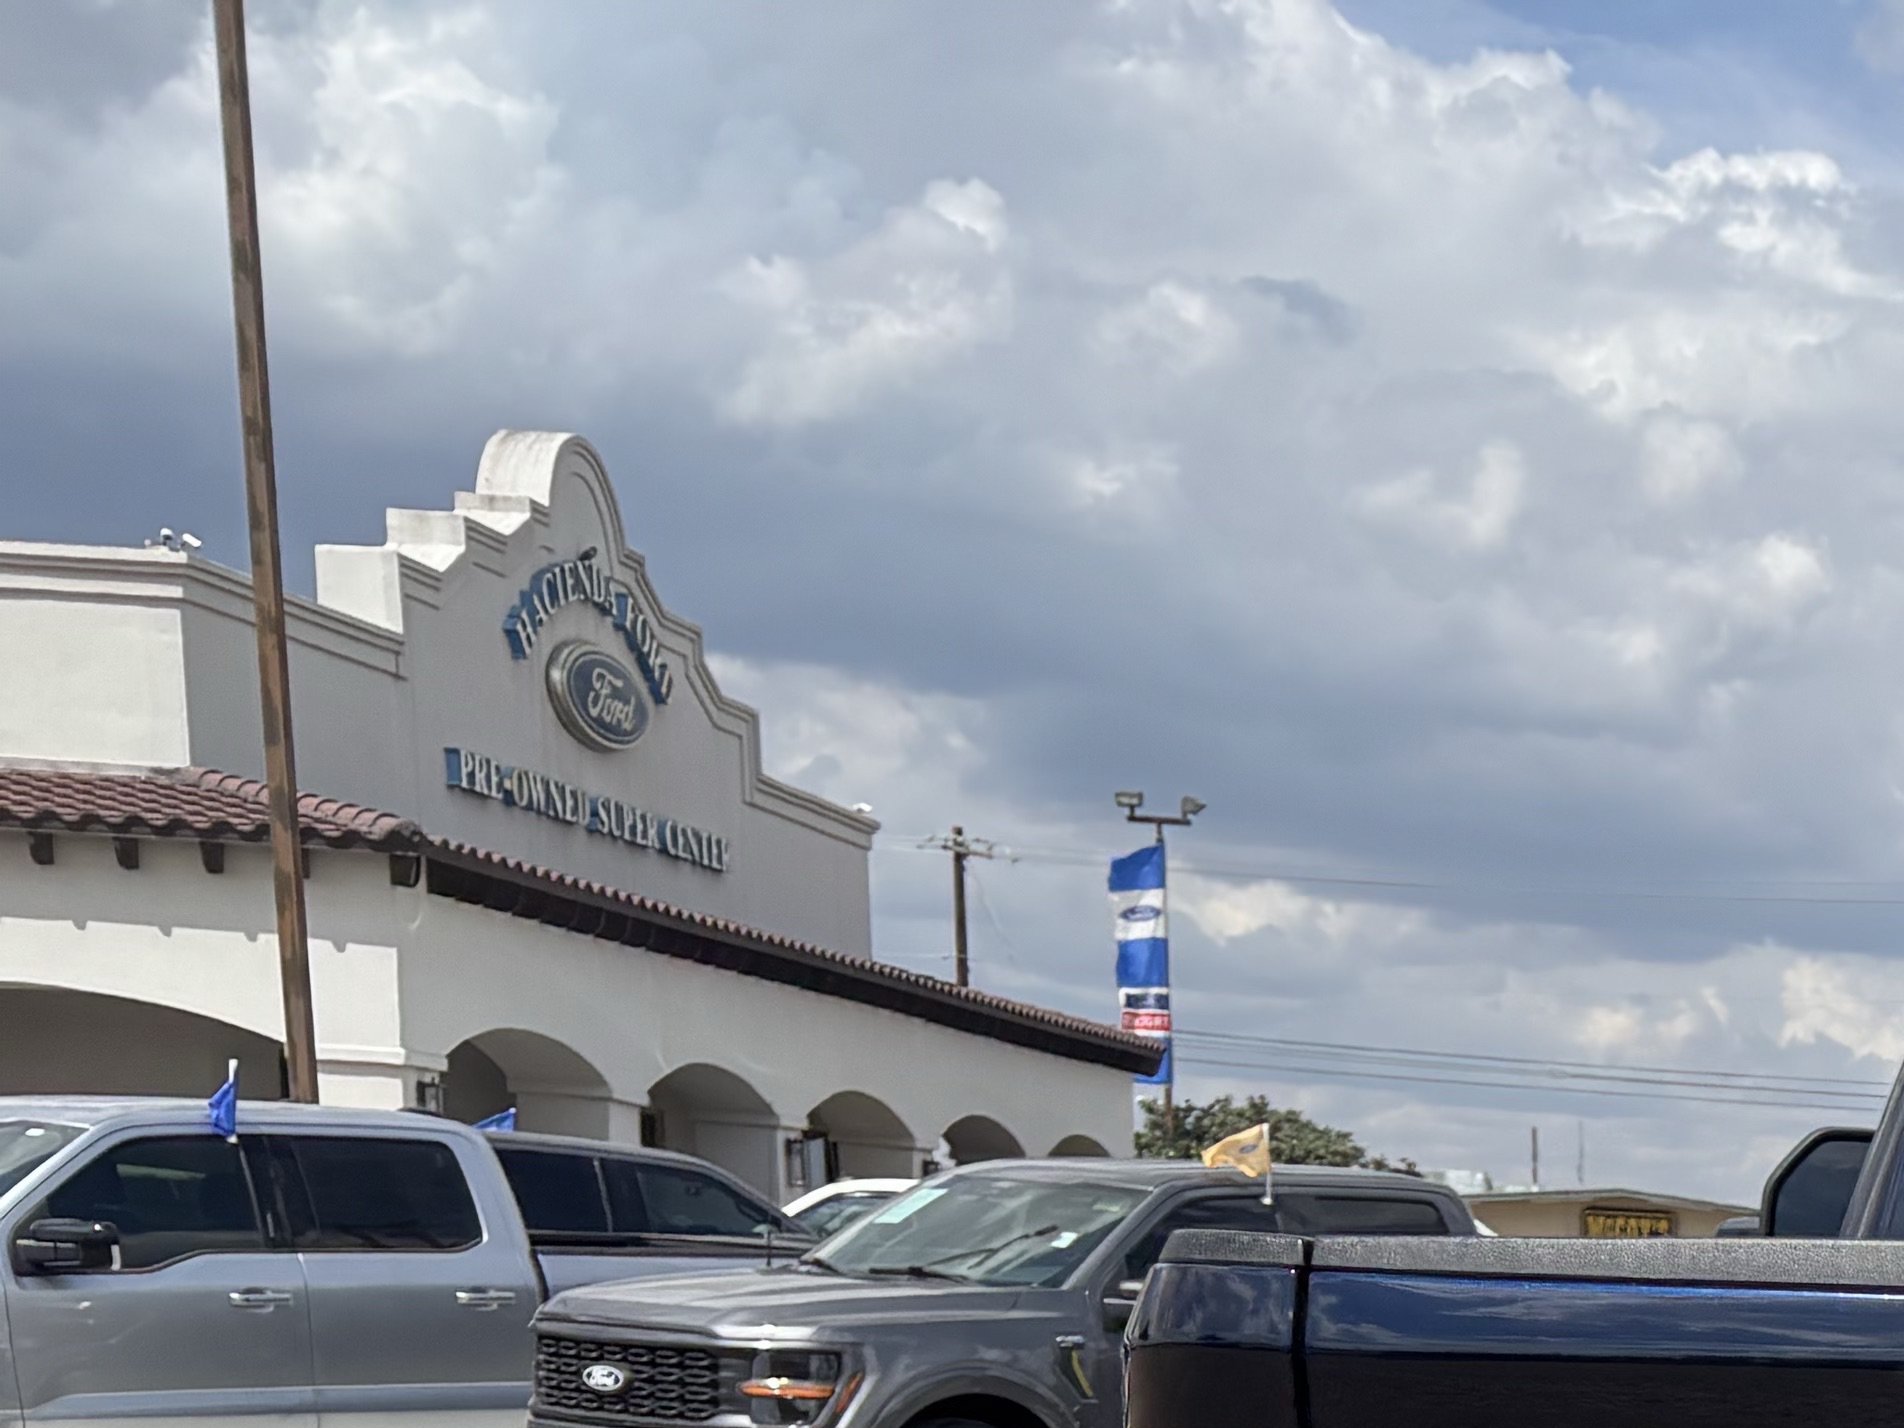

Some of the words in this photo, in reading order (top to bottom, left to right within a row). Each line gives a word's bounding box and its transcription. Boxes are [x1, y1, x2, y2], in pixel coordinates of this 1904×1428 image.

[588, 667, 636, 731] Ford
[456, 750, 590, 823] PRE-OWNED
[597, 796, 660, 849] SUPER
